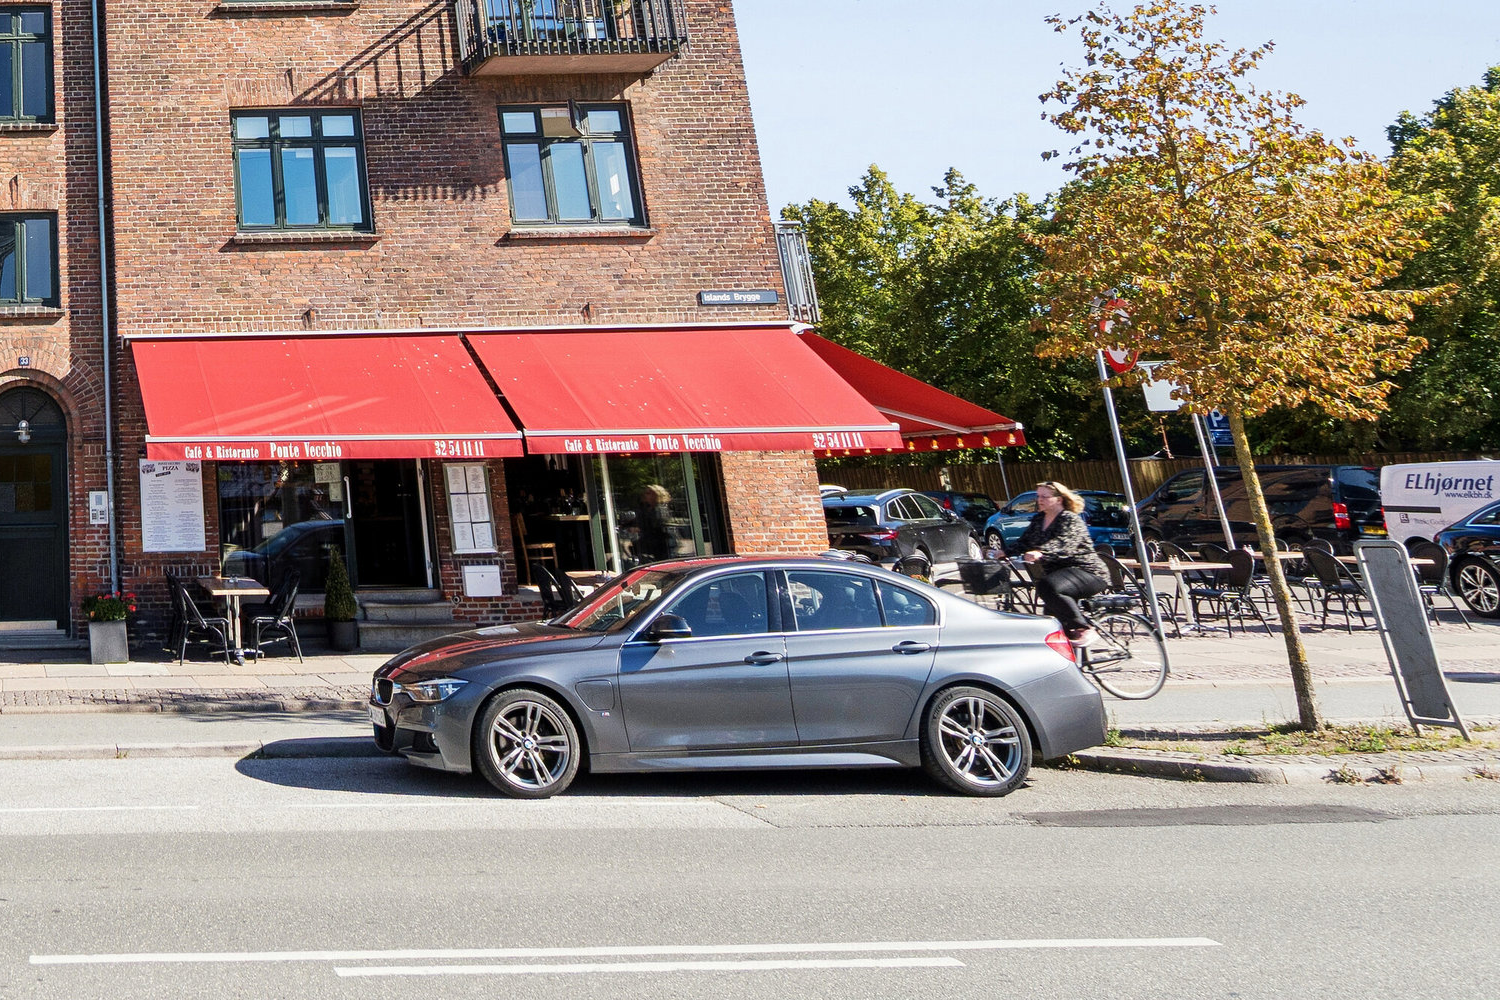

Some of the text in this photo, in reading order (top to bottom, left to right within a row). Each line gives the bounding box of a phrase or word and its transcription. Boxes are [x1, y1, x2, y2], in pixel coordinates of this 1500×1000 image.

[703, 293, 760, 302] Islands Brygge
[20, 357, 29, 365] 33
[1210, 408, 1223, 427] P
[434, 440, 485, 456] 32 54 11 11
[564, 438, 639, 452] Café & Ristorante
[648, 434, 722, 450] Ponte Vecchio
[812, 432, 864, 448] 32 54 11 11
[185, 445, 259, 459] Café & Ristorante
[269, 441, 342, 458] Ponte Vecchio
[1405, 473, 1494, 495] ELhjørnet
